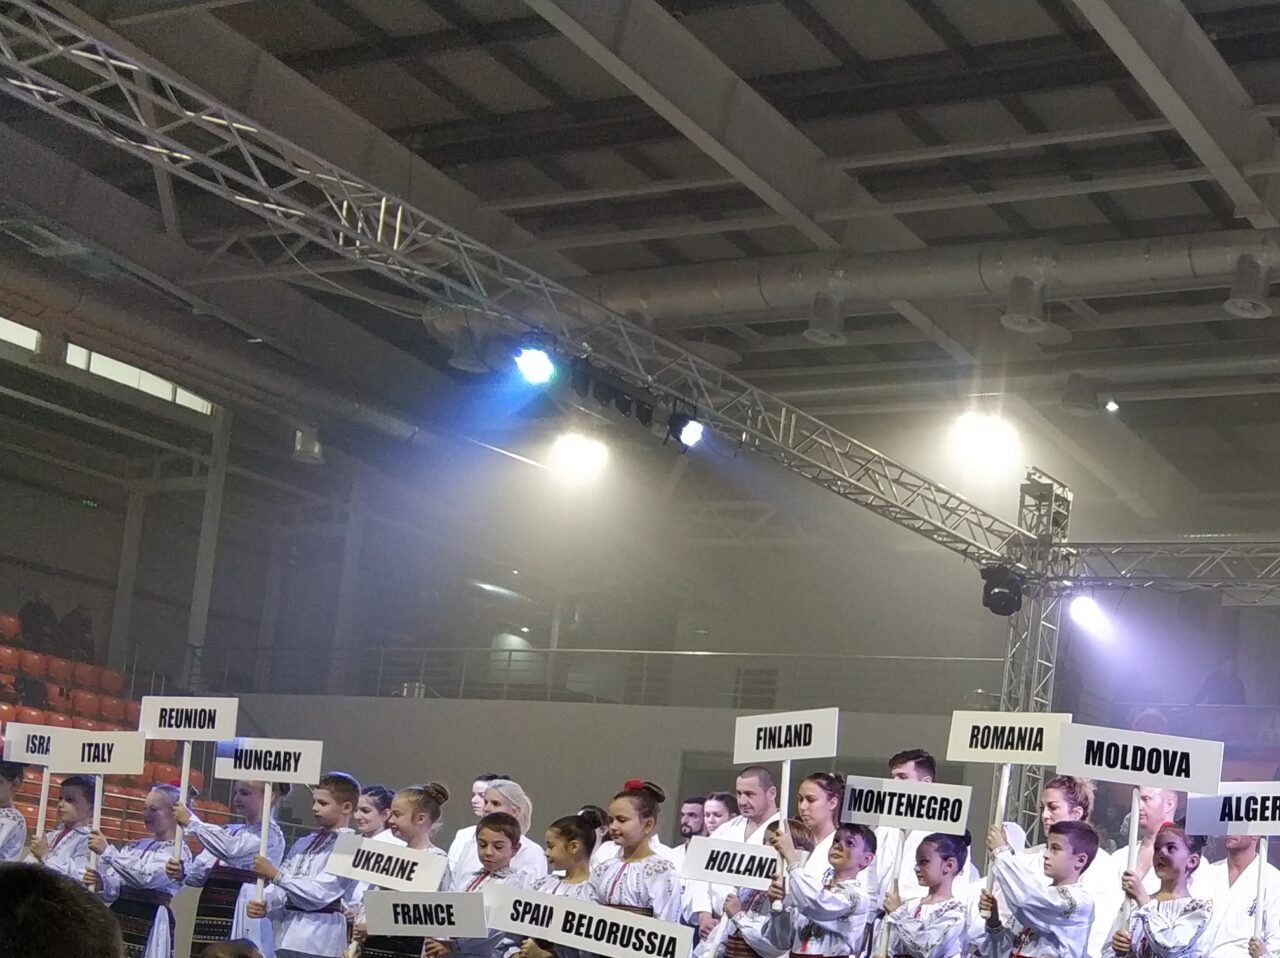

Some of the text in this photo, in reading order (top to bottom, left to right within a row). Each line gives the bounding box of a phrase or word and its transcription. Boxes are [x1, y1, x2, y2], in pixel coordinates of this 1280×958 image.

[158, 707, 217, 731] REUNION
[755, 722, 813, 750] FINLAND
[969, 725, 1044, 753] ROMANIA
[81, 742, 115, 763] ITALY
[233, 747, 302, 773] HUNGARY
[1085, 739, 1191, 778] MOLDOVA
[848, 787, 963, 823] MONTENEGRO
[351, 848, 419, 882] UKRAINE
[391, 902, 456, 927] FRANCE
